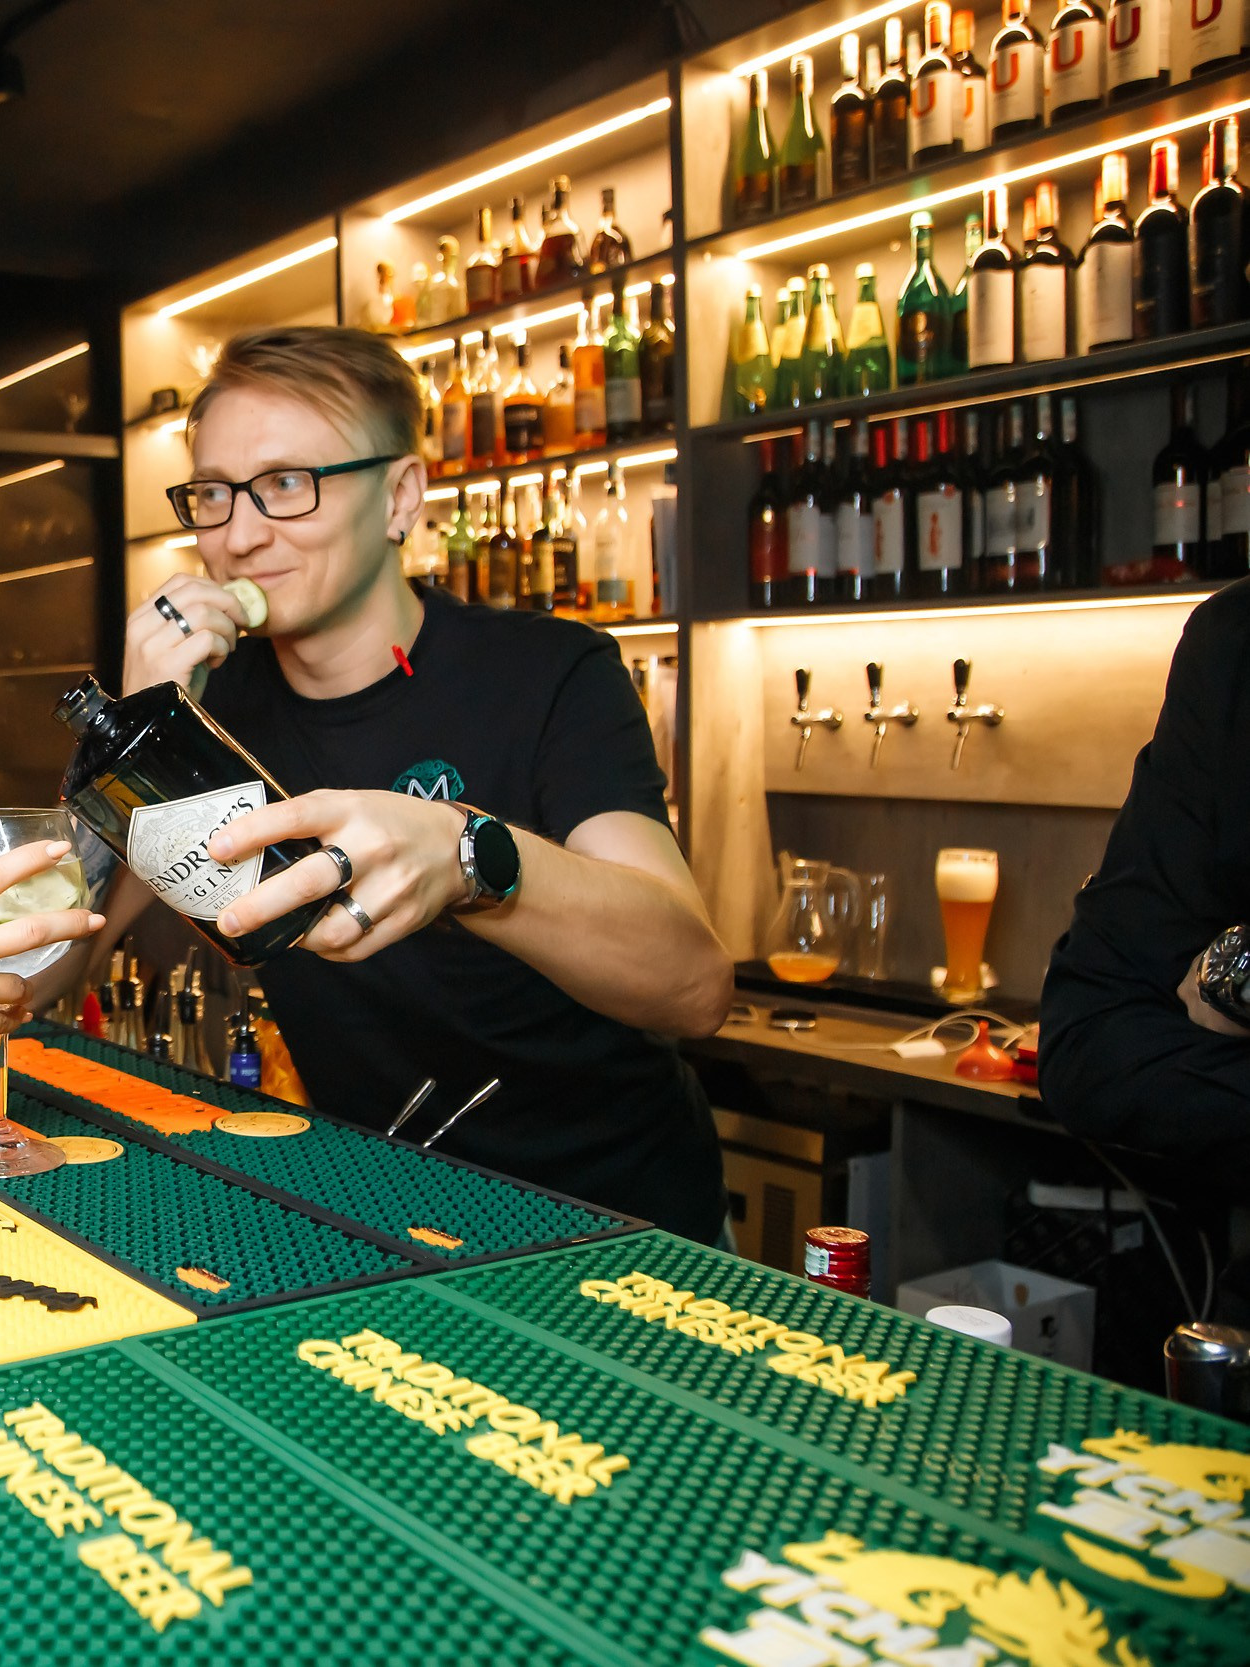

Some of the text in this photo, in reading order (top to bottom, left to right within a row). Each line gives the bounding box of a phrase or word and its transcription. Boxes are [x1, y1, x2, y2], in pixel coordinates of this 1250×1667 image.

[193, 862, 233, 897] GIN
[579, 1279, 897, 1408] CHINESE BEER
[617, 1271, 916, 1398] TRADITIONAL
[297, 1338, 597, 1505] CHINESE BEER
[341, 1329, 630, 1489] TRADITIONAL
[3, 1401, 253, 1607] TRADITIONAL
[77, 1533, 201, 1633] BEER
